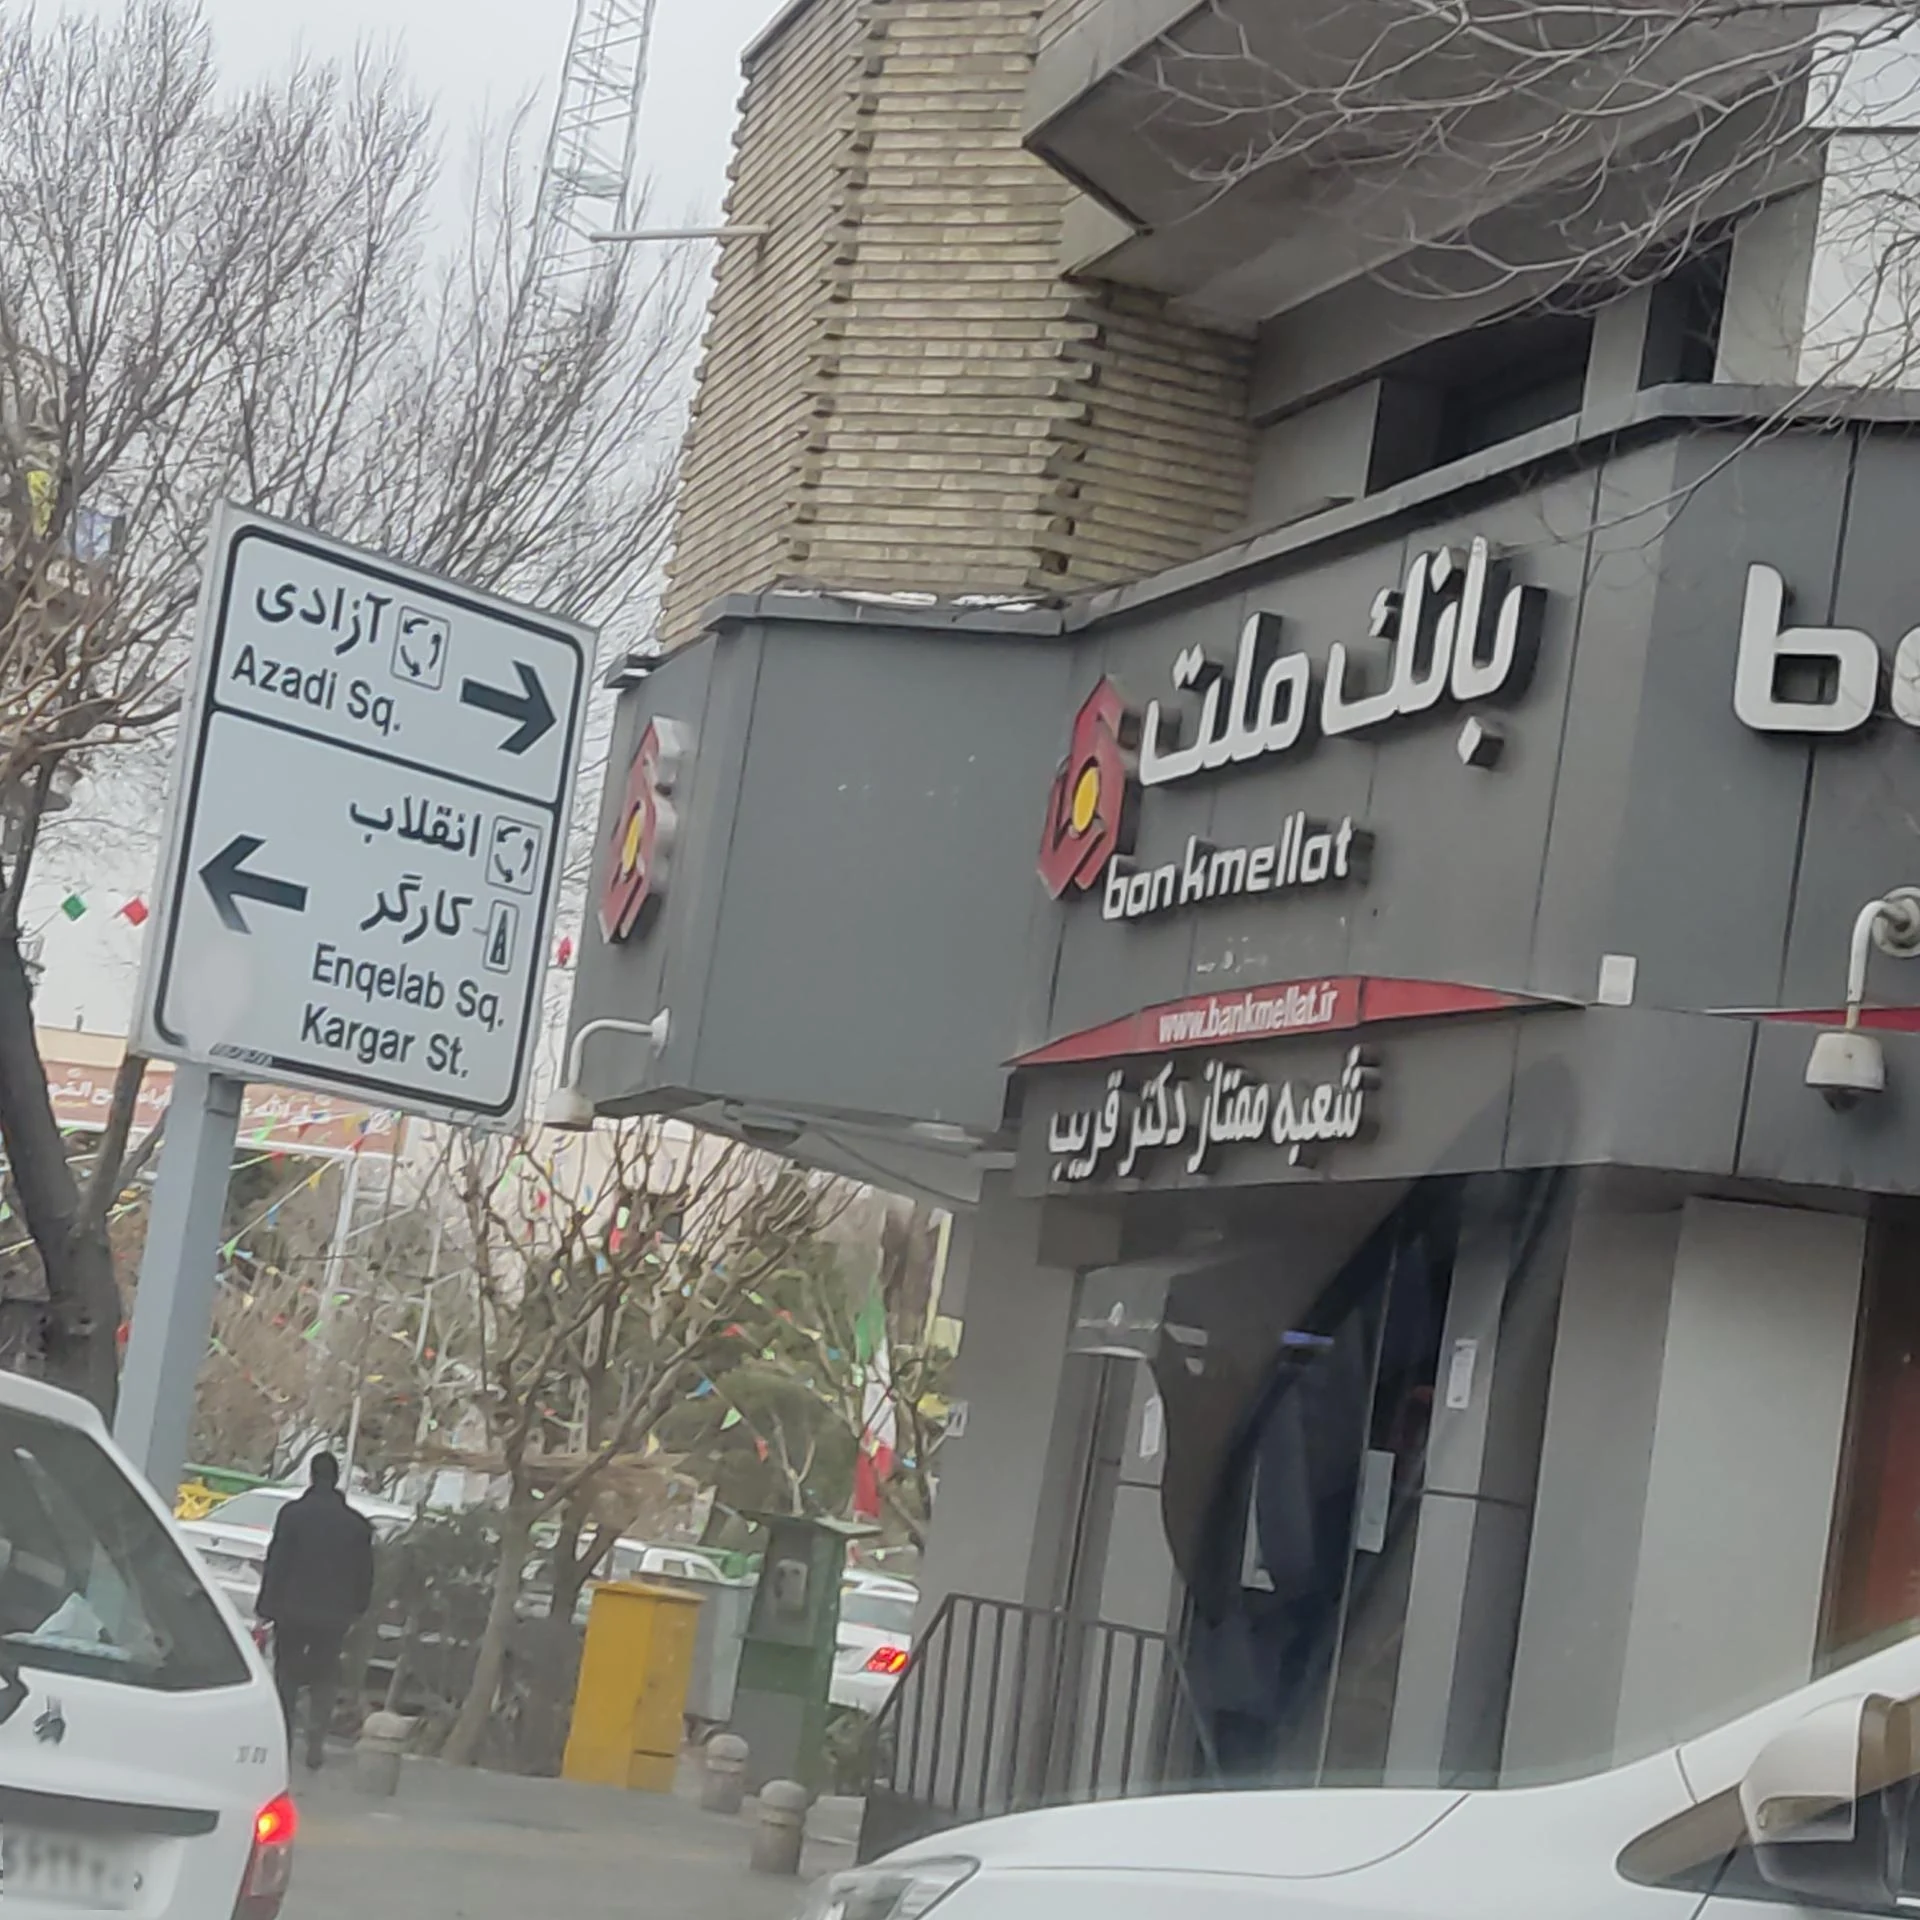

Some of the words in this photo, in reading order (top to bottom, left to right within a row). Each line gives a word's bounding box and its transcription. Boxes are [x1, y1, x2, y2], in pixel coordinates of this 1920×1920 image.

[256, 580, 393, 655] آزادی
[230, 643, 336, 711] Azadi
[346, 679, 402, 735] Sq.
[1138, 611, 1310, 785] ملت
[349, 796, 483, 857] انقلاب
[360, 873, 474, 944] کارگر
[311, 942, 446, 1012] Enqelab
[455, 980, 505, 1029] Sq.
[1158, 981, 1341, 1045] www.bankmellat.ir
[300, 1002, 417, 1067] Kargar
[425, 1032, 469, 1078] St.
[1047, 1068, 1124, 1182] قریب
[1117, 1061, 1187, 1177] دکتر
[1187, 1058, 1271, 1174] ممتاز
[1271, 1044, 1365, 1167] شعبه
